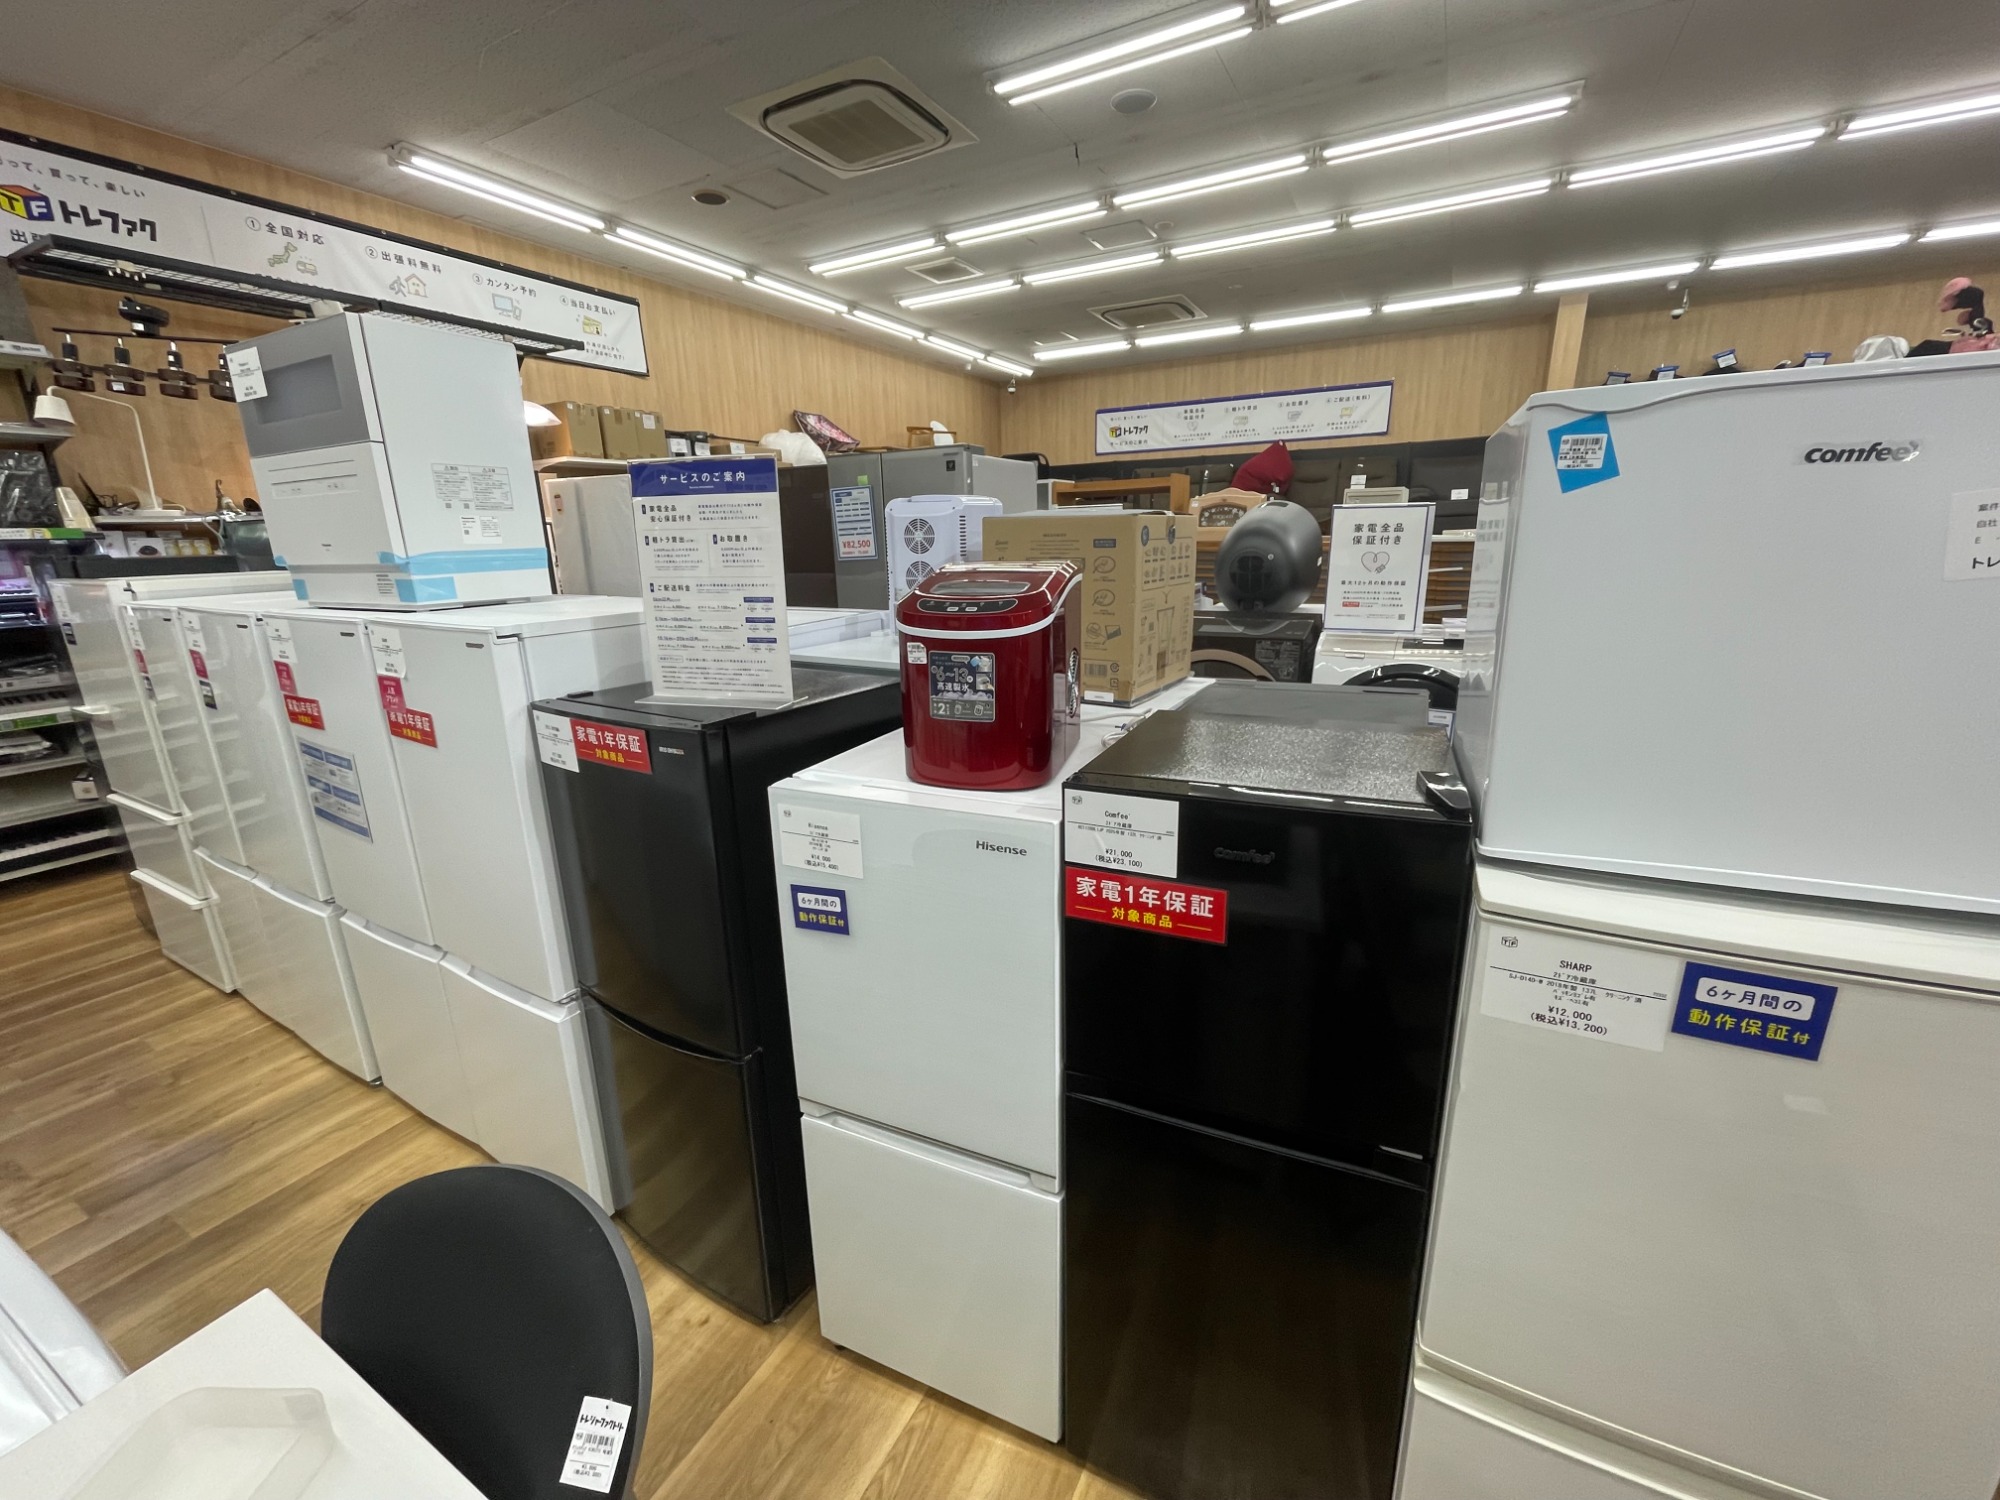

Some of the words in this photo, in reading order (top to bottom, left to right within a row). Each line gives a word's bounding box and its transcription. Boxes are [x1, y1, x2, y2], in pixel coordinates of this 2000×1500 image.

[0, 158, 145, 198] って、買って、楽しい
[58, 200, 157, 242] トレファク
[1123, 425, 1148, 436] トレファク
[660, 471, 746, 484] サービスのご案内
[1354, 523, 1404, 533] 家電全品
[842, 540, 871, 550] ¥82,500
[1352, 535, 1402, 545] 保証付き
[575, 726, 642, 753] 家電1年保証
[595, 748, 625, 763] 対象商品
[976, 840, 1028, 856] Hisense
[1105, 848, 1133, 858] ¥21,000
[1076, 876, 1214, 918] 家電1年保証
[1111, 906, 1173, 928] 対象商品
[1559, 960, 1592, 973] SHARP
[1548, 1005, 1593, 1022] ¥12,000
[1531, 1012, 1608, 1036] (税込¥13,200)
[1688, 1008, 1811, 1045] 動作保証付
